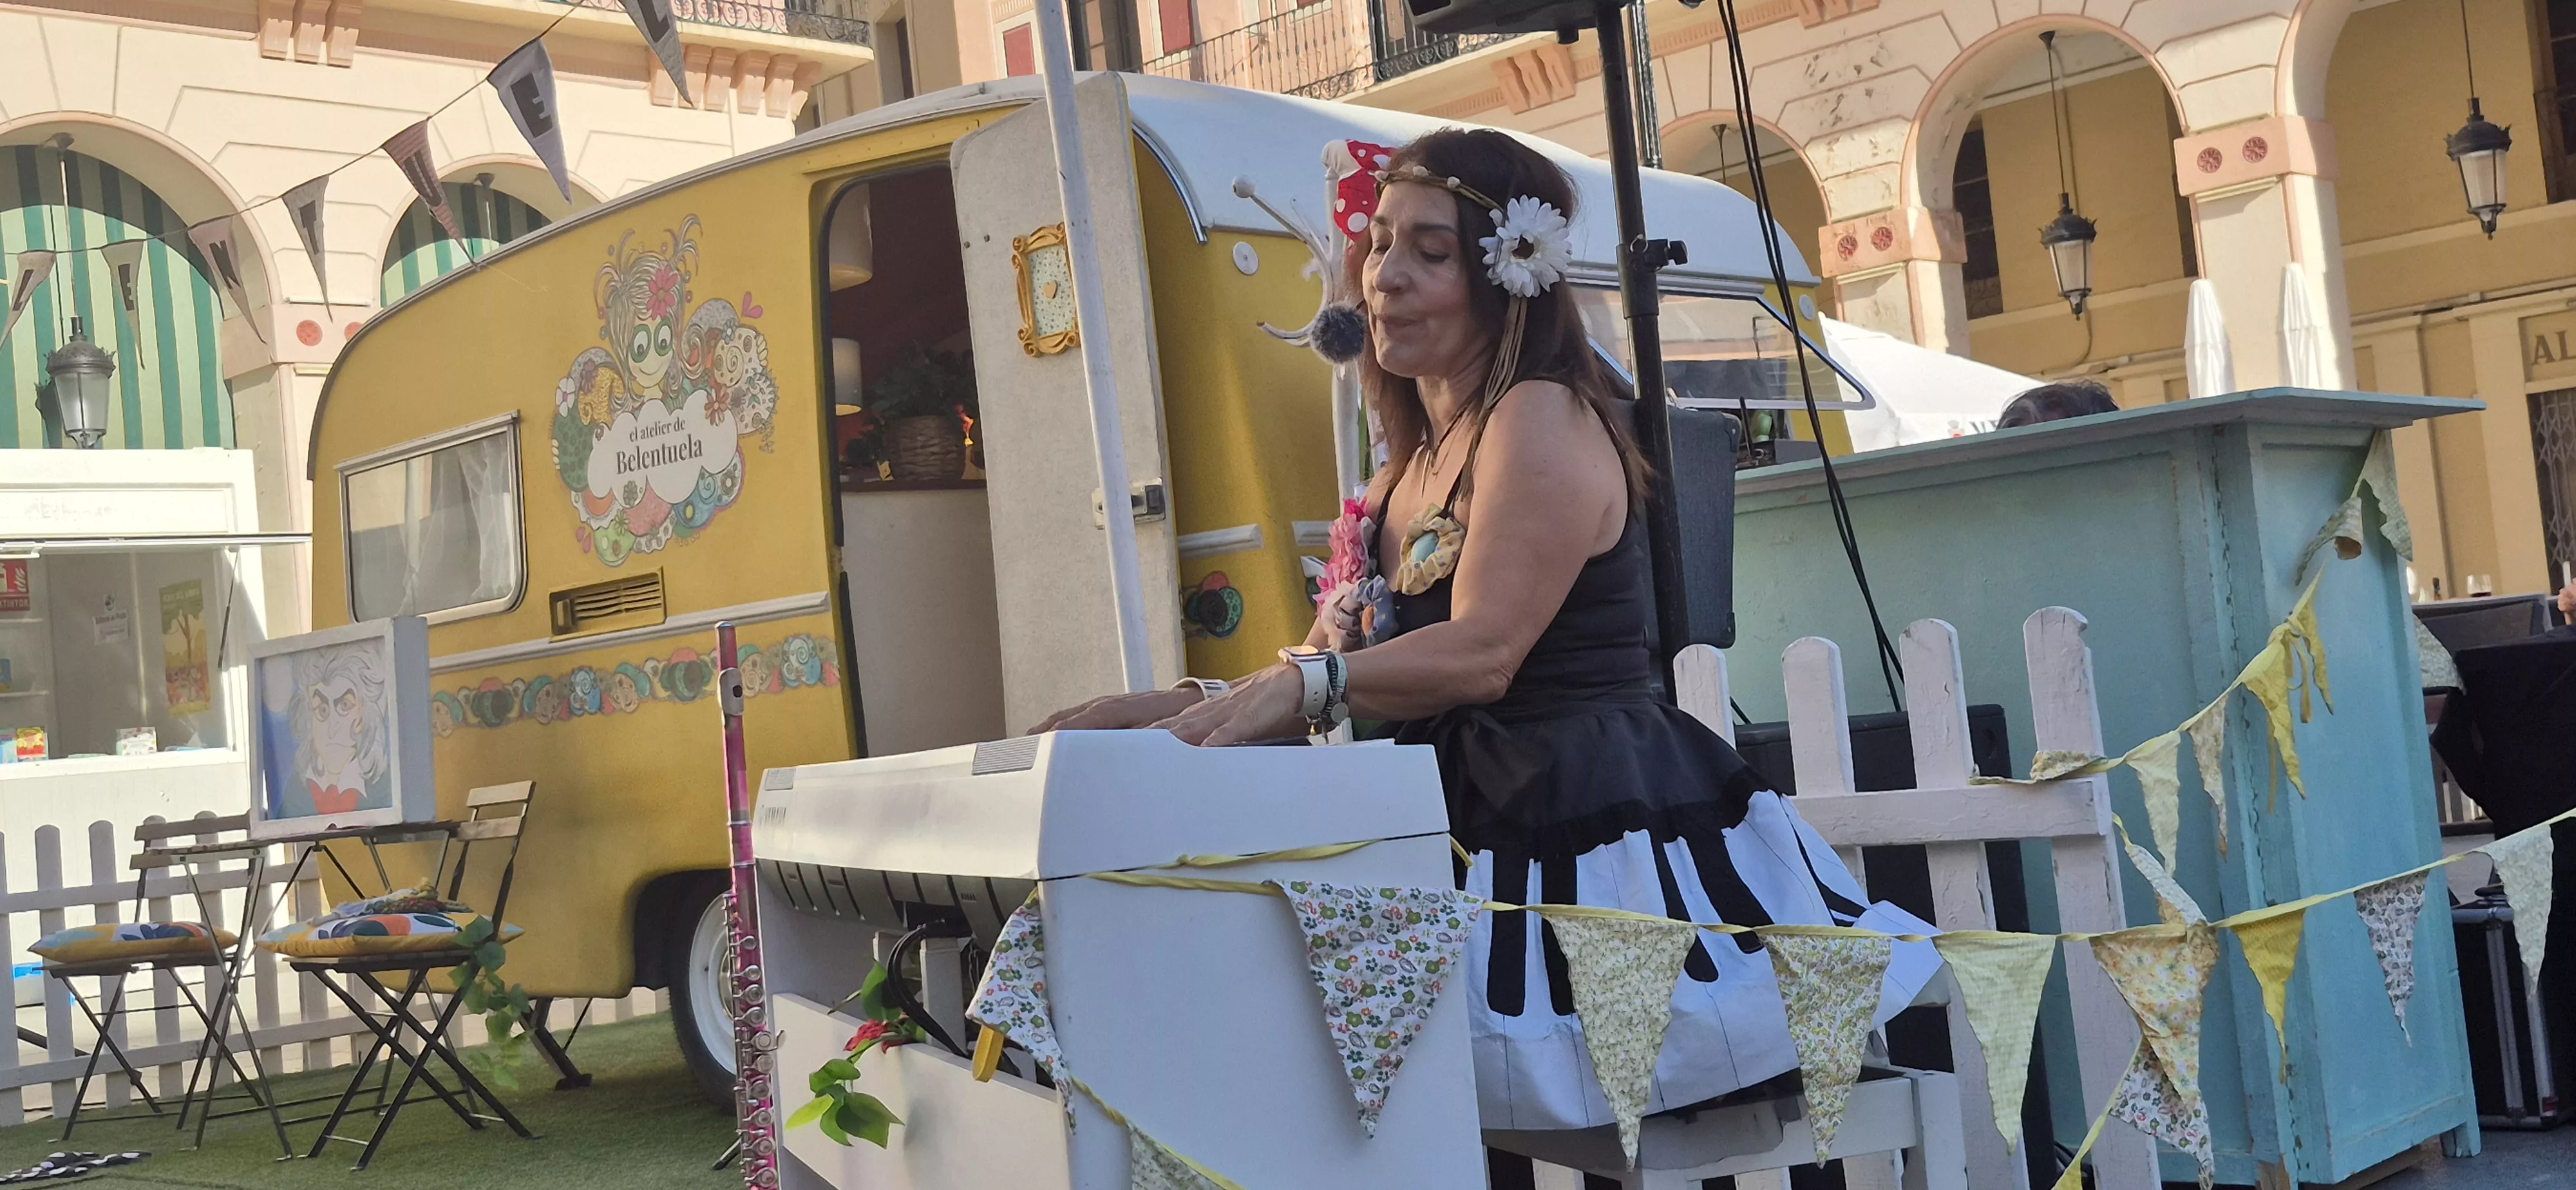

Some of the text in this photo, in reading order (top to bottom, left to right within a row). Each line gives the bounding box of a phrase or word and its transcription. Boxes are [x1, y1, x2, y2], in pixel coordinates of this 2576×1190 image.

[629, 416, 686, 442] el atelier de
[616, 433, 703, 475] Belentuela
